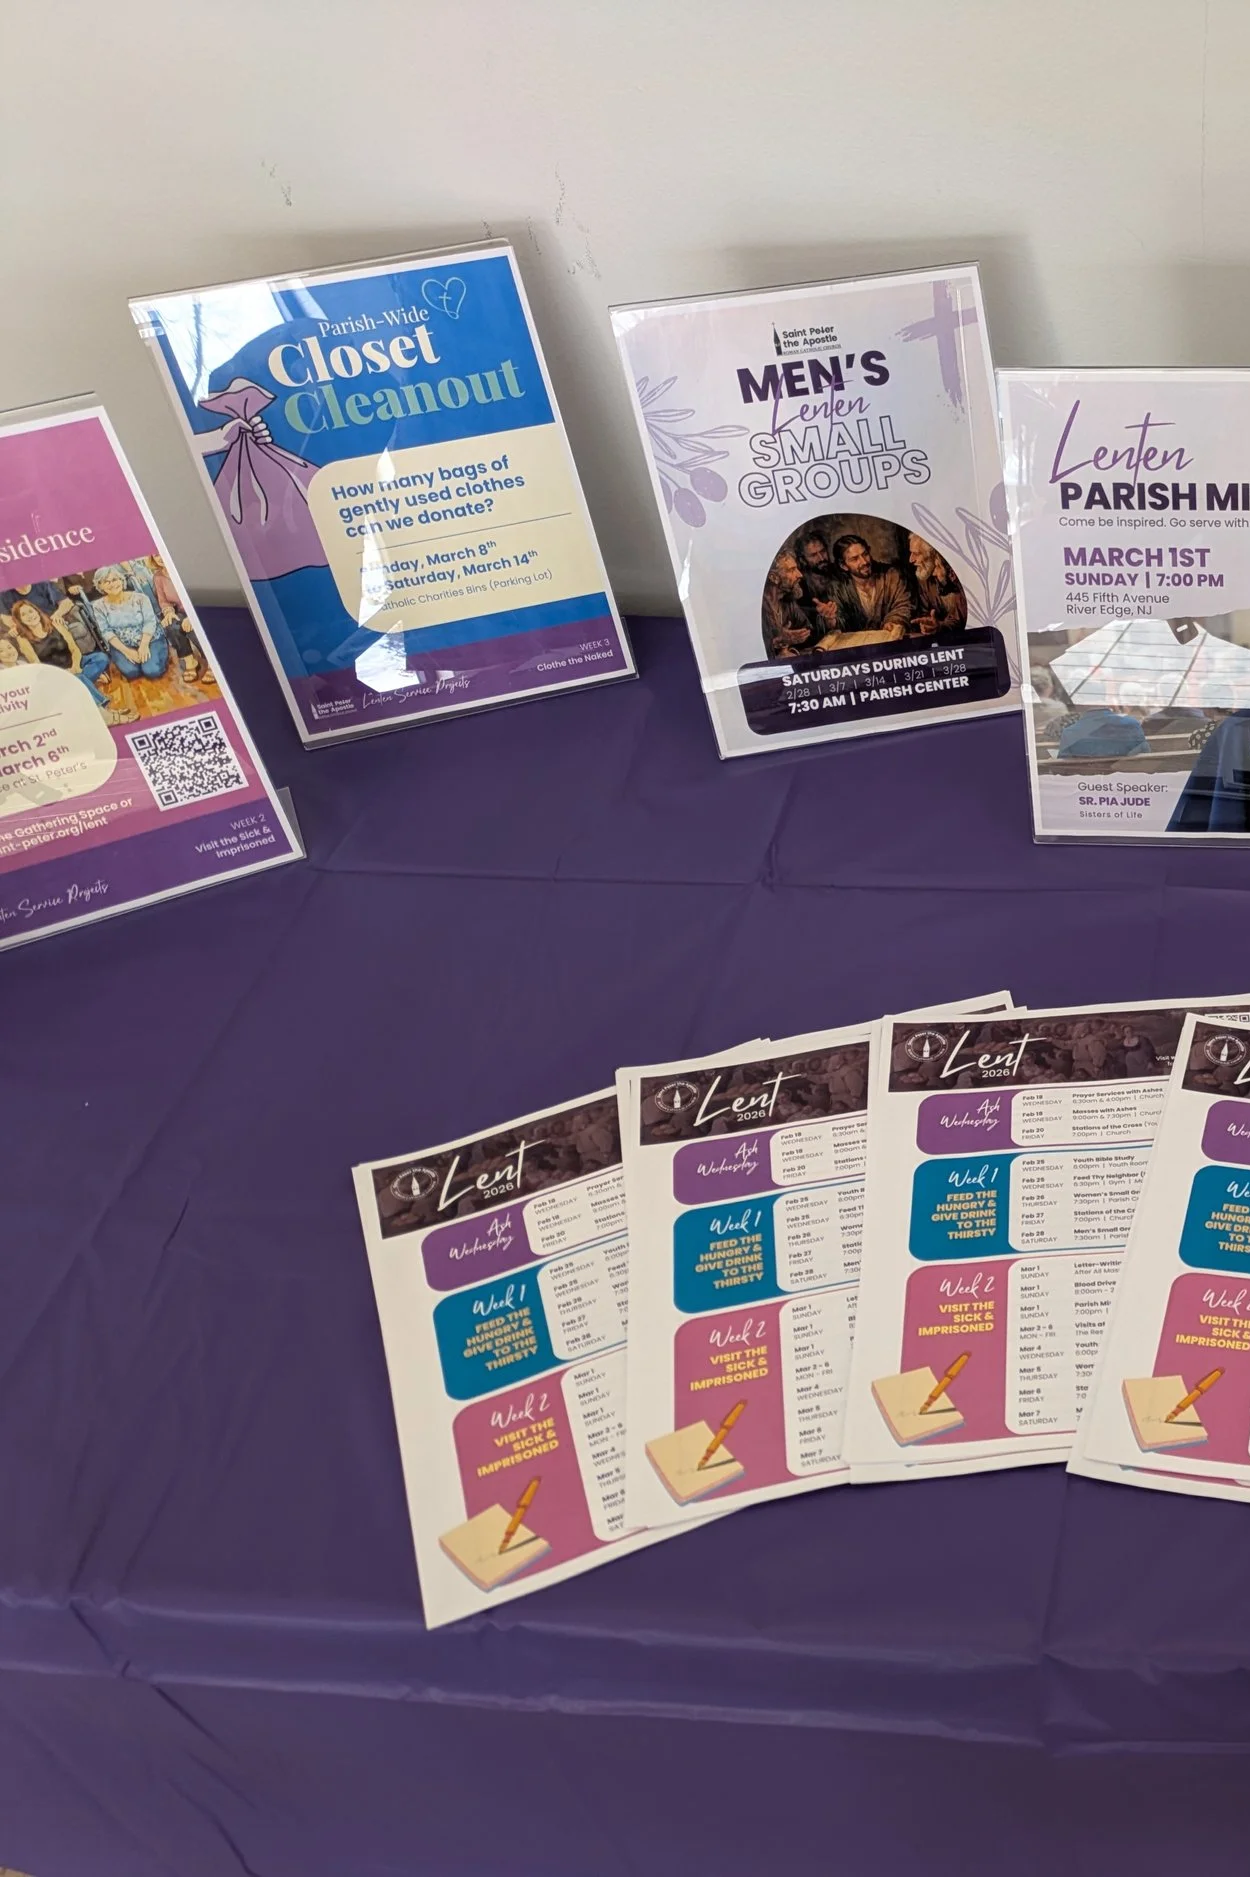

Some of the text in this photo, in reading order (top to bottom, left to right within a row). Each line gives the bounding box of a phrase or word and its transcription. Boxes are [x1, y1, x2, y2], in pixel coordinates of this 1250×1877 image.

[318, 306, 430, 338] Parish-Wide
[782, 325, 834, 339] Saint Peter
[268, 324, 440, 387] Closet
[783, 334, 837, 348] the Apostle
[736, 350, 890, 404] MEN'S
[284, 360, 526, 433] Cleanout
[772, 373, 870, 436] Lenten
[750, 415, 906, 469] SMALL
[1049, 400, 1194, 489] Lenten
[332, 481, 374, 500] How
[439, 462, 487, 481] bags
[491, 455, 509, 471] of
[738, 449, 931, 508] GROUPS
[339, 474, 525, 523] gently used clothes
[1060, 482, 1198, 510] PARISH
[346, 498, 494, 538] can we donate?
[1059, 517, 1096, 527] Come
[1099, 517, 1113, 527] be
[1116, 517, 1166, 530] inspired.
[1170, 518, 1186, 528] Go
[1189, 520, 1222, 528] serve
[1224, 518, 1249, 528] with
[462, 556, 512, 577] March
[513, 549, 538, 566] 14th
[1064, 547, 1210, 567] MARCH 1ST
[418, 569, 553, 604] Charities Bins (Parking Lot)
[1065, 573, 1224, 587] SUNDAY 7:00 PM
[1065, 591, 1169, 603] 445 Fifth Avenue
[1066, 604, 1152, 617] River Edge, NJ
[537, 649, 613, 672] Clothe the Naked
[782, 648, 964, 687] SATURDAYS DURING LENT
[2, 686, 31, 703] your
[789, 676, 969, 713] 7:30 AM PARISH CENTER
[1078, 782, 1168, 795] Guest Speaker:
[1079, 796, 1150, 806] SR. PIA JUDE
[15, 798, 133, 838] Gathering Space or
[195, 829, 260, 853] Visit the Sick
[216, 835, 276, 858] Imprisoned
[940, 1030, 1047, 1079] Lent
[693, 1071, 802, 1126] Lent
[438, 1140, 545, 1211] Lent
[918, 1323, 993, 1336] IMPRISONED
